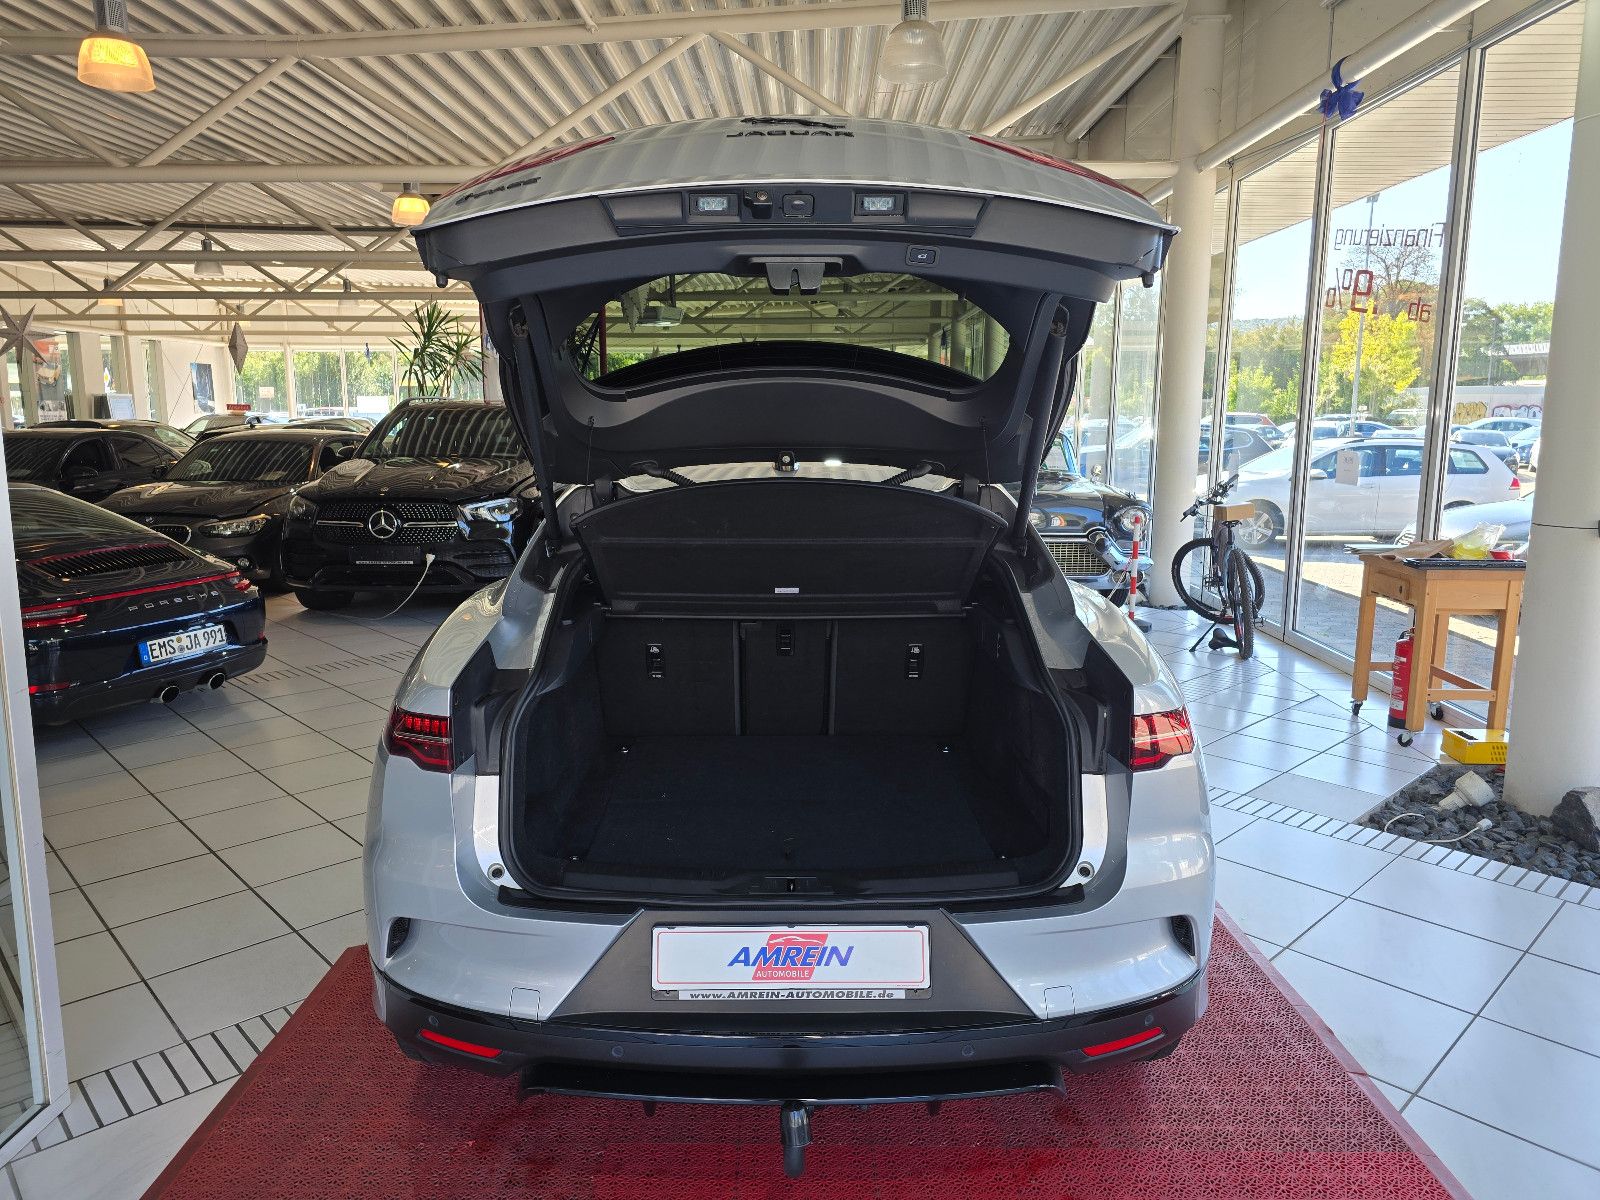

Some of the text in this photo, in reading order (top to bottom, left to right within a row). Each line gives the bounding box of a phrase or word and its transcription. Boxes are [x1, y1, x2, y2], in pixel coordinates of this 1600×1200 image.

[127, 590, 219, 612] PORSCHE
[148, 627, 226, 660] EMS JA 991
[726, 945, 855, 967] AMREIN
[755, 970, 810, 978] AUTOMOBILE
[689, 989, 895, 1000] www.AMREIN-AUTOMOBILE.de
